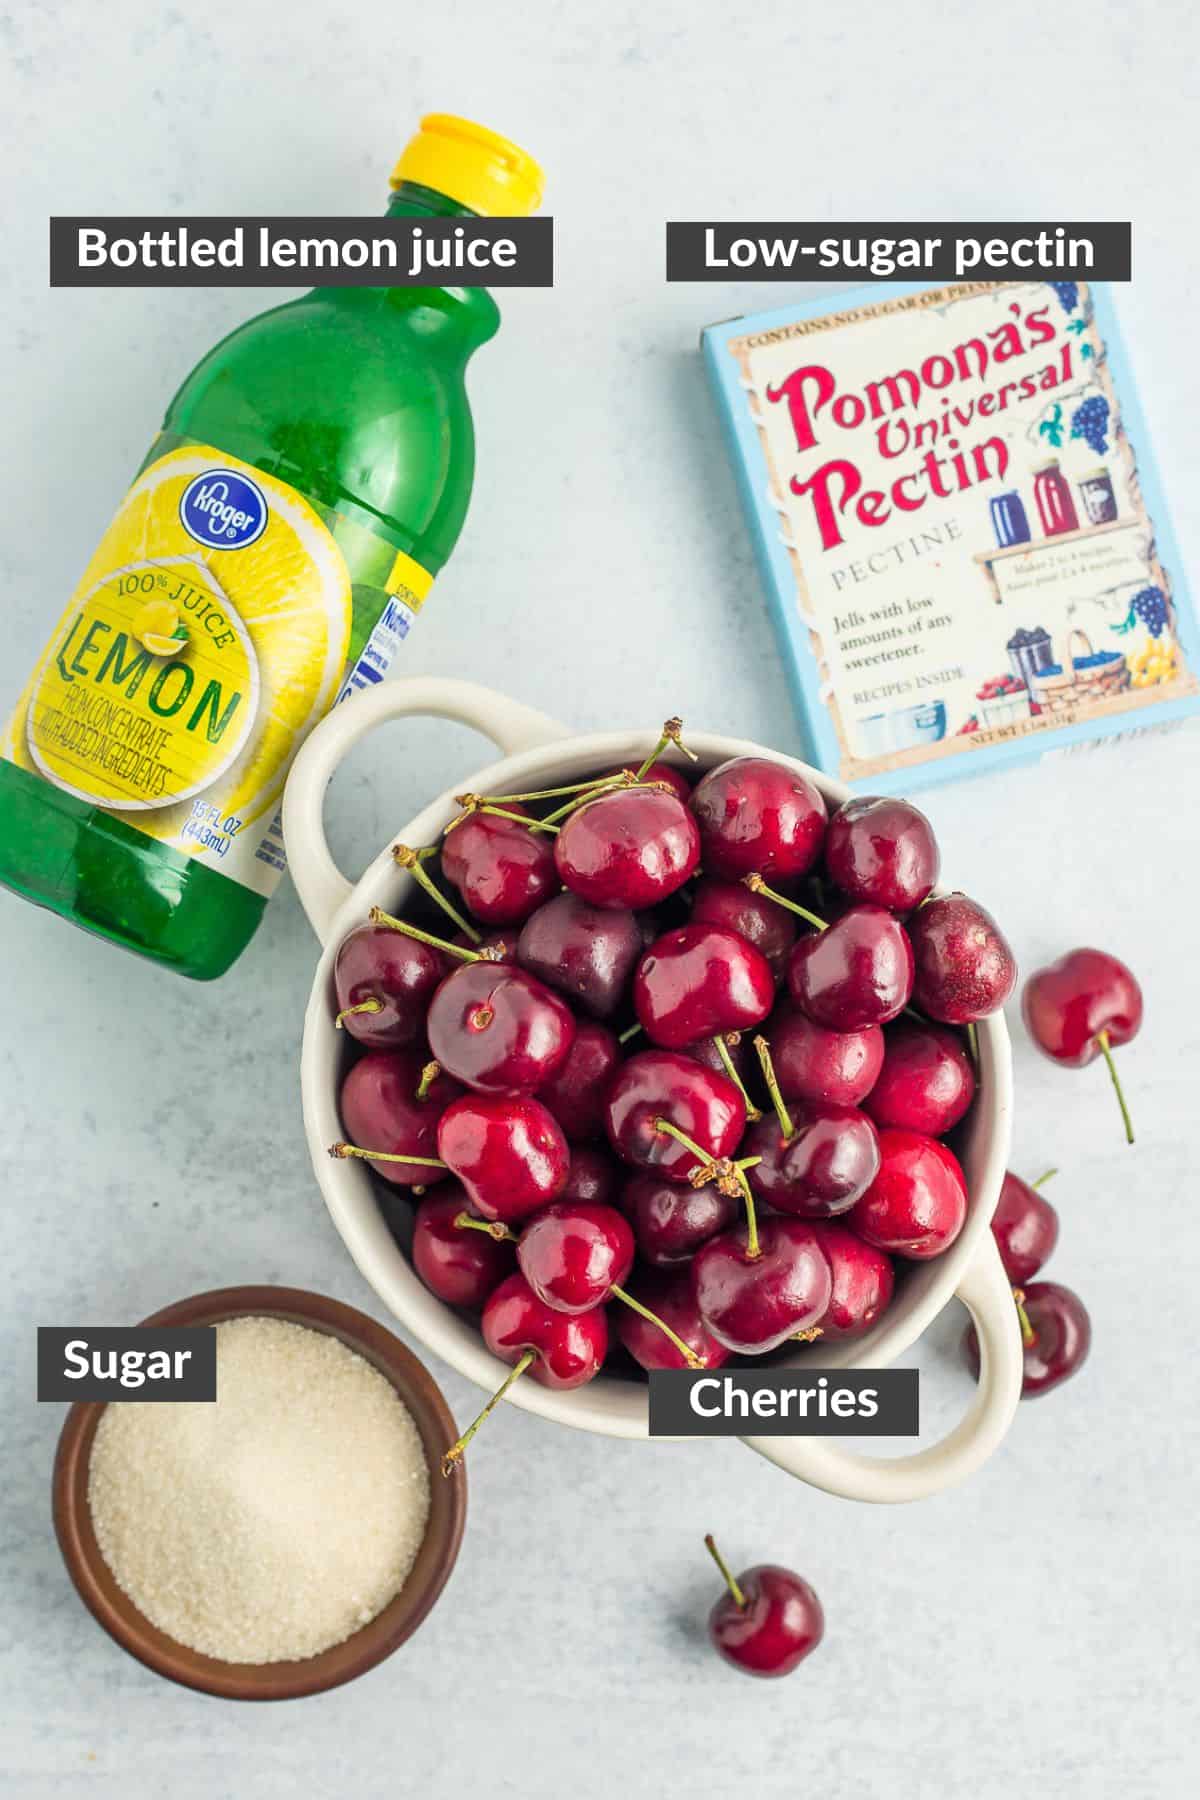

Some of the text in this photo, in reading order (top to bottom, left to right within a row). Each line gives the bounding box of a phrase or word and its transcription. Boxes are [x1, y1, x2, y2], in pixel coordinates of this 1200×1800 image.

[747, 319, 830, 348] CONTAINS
[833, 310, 860, 326] NO
[863, 297, 917, 318] SUGAR
[919, 291, 944, 307] OR
[766, 302, 1057, 453] Pomona's
[876, 343, 1074, 459] Universal
[193, 481, 255, 535] Kroger
[789, 436, 1009, 552] Pectin
[831, 518, 964, 591] PECTINE
[118, 574, 236, 649] 100% JUICE
[832, 598, 935, 635] Jells with low
[840, 613, 953, 652] amounts of any
[56, 613, 242, 745] LEMON
[844, 642, 926, 671] sweetener.
[853, 665, 966, 705] RECIPES INSIDE
[60, 683, 173, 760] FROM CONCENTRATE
[94, 735, 172, 796] INGREDIENTS
[181, 819, 232, 858] (443mL)
[192, 800, 243, 837] 15 FL OZ
